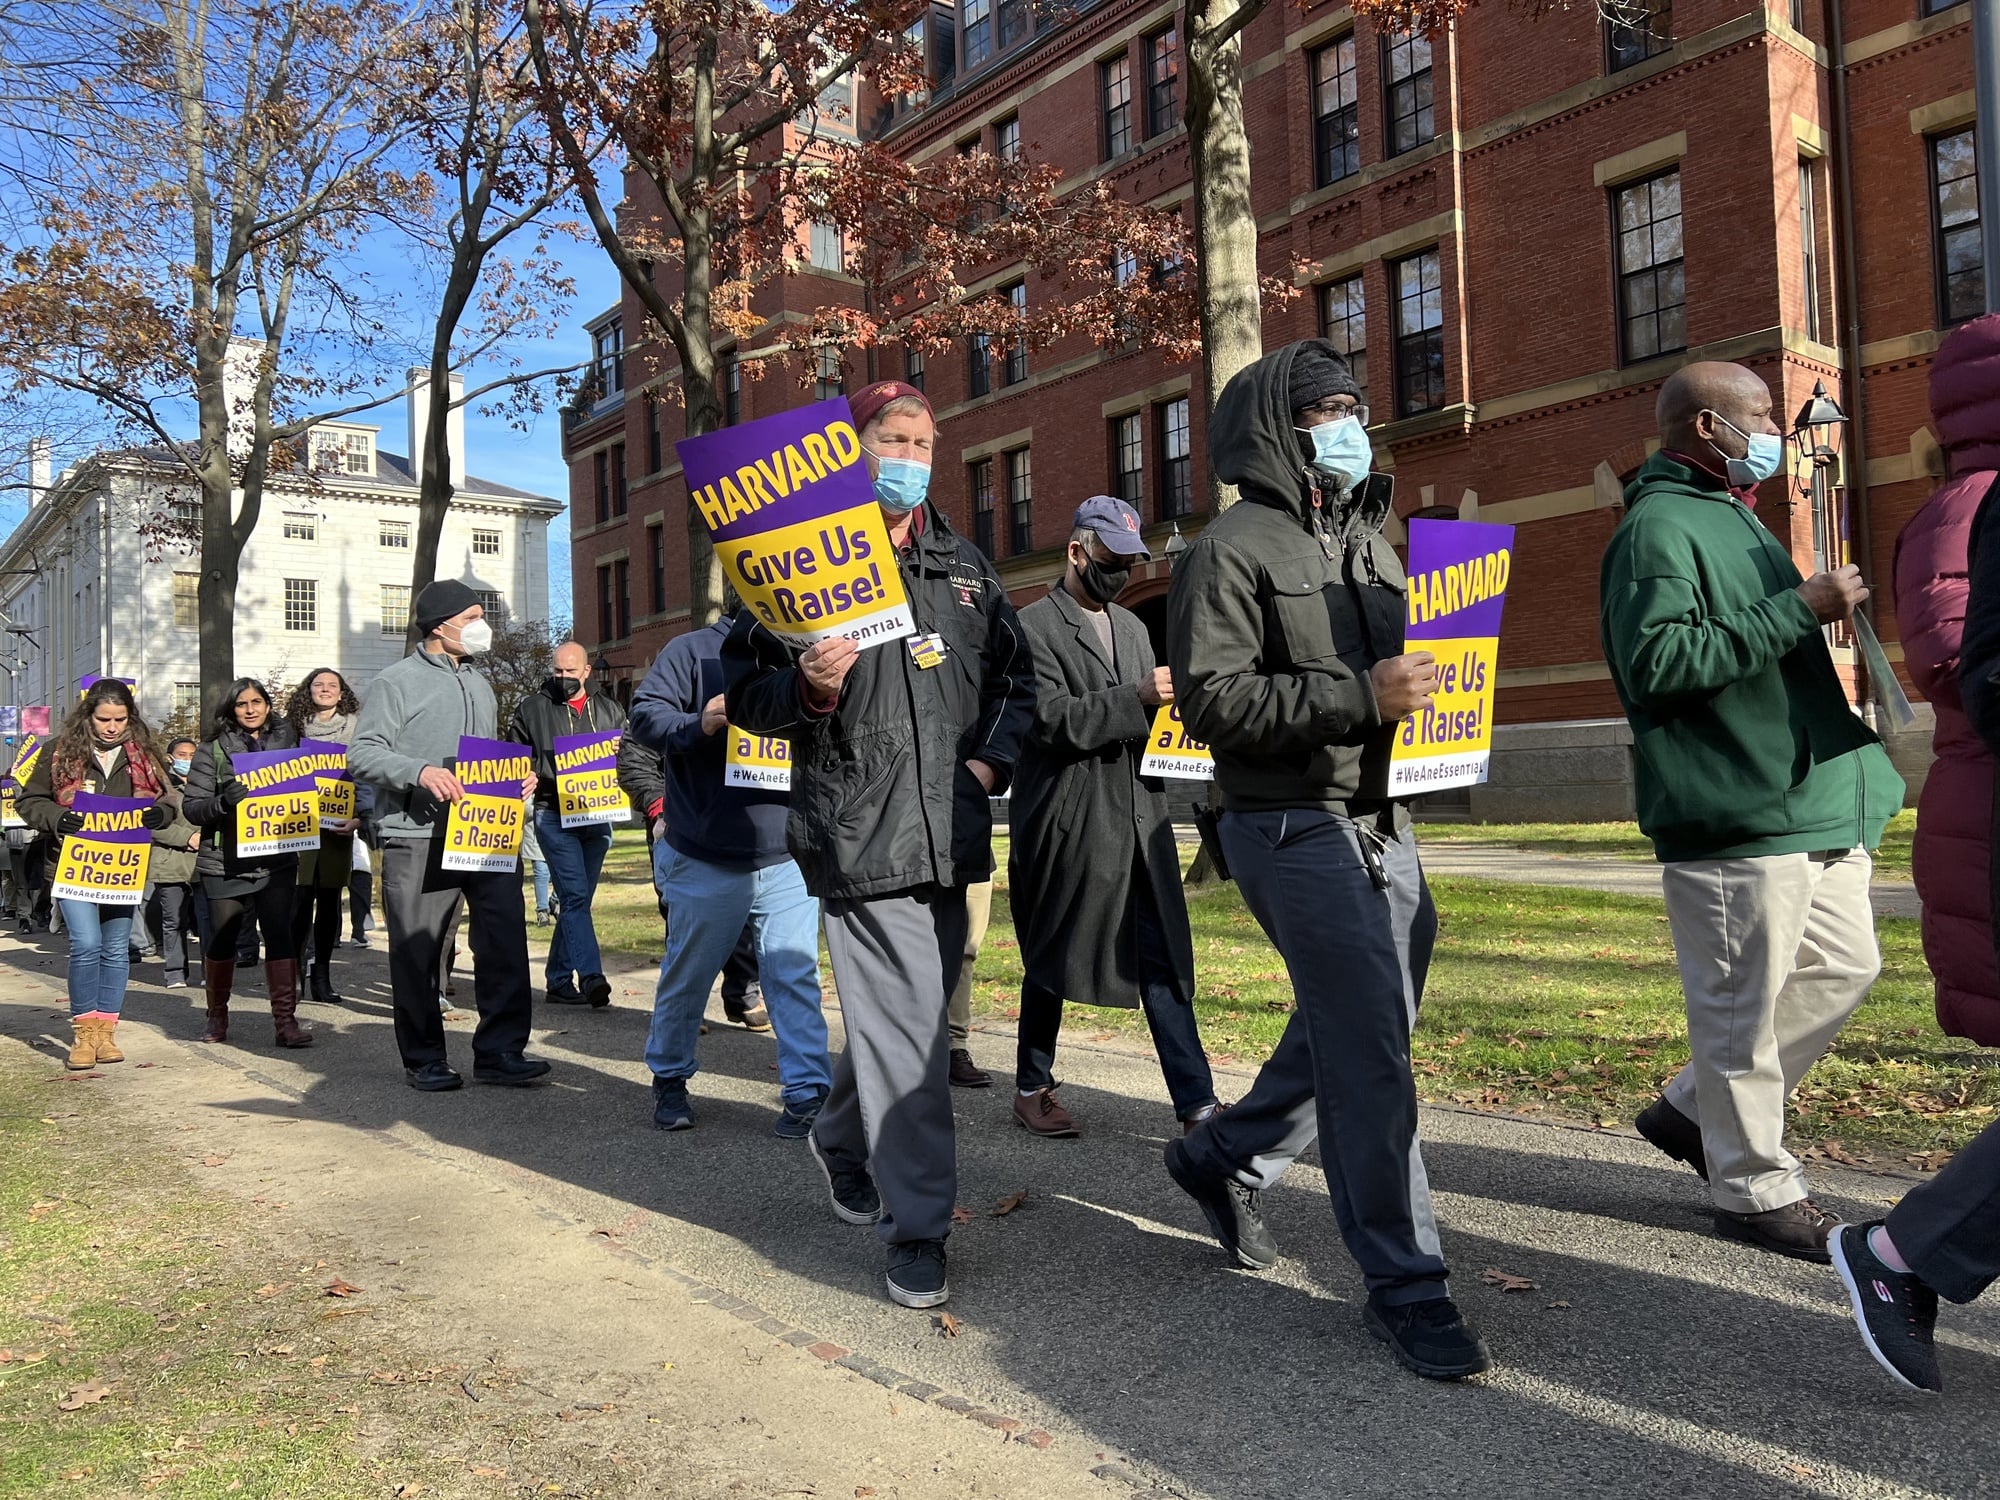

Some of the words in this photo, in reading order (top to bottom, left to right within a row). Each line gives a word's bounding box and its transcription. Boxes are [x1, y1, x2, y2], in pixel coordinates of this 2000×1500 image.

[692, 421, 861, 531] HARVARD
[736, 546, 817, 587] Give
[819, 525, 872, 566] Us
[755, 599, 777, 624] a
[773, 562, 886, 624] Raise!
[1407, 548, 1511, 626] HARVARD
[1434, 661, 1457, 695] ve
[1462, 651, 1486, 695] Us
[1402, 712, 1415, 747] a
[1421, 698, 1484, 745] Raise!
[737, 738, 751, 757] a
[1158, 731, 1173, 748] a
[554, 738, 618, 772] HARVAR
[1149, 759, 1214, 774] #WeAreEss
[455, 756, 531, 785] HARVARD
[733, 769, 790, 784] #WeAreEs
[1396, 762, 1484, 785] #WeAreEssential
[317, 785, 331, 797] ve
[335, 784, 350, 799] Us
[565, 779, 598, 794] Give
[601, 774, 619, 789] Us
[246, 802, 285, 820] Give
[290, 798, 310, 815] Us
[320, 801, 349, 815] aise!
[566, 800, 574, 811] a
[578, 790, 622, 810] Raise!
[69, 807, 152, 832] ARVAR
[458, 800, 496, 824] Give
[500, 804, 517, 826] Us
[245, 826, 255, 838] a
[260, 816, 312, 837] Raise!
[453, 830, 463, 846] a
[468, 825, 515, 850] Raise!
[70, 843, 113, 866] Give
[118, 849, 140, 867] Us
[64, 867, 75, 881] a
[80, 865, 138, 886] Raise!
